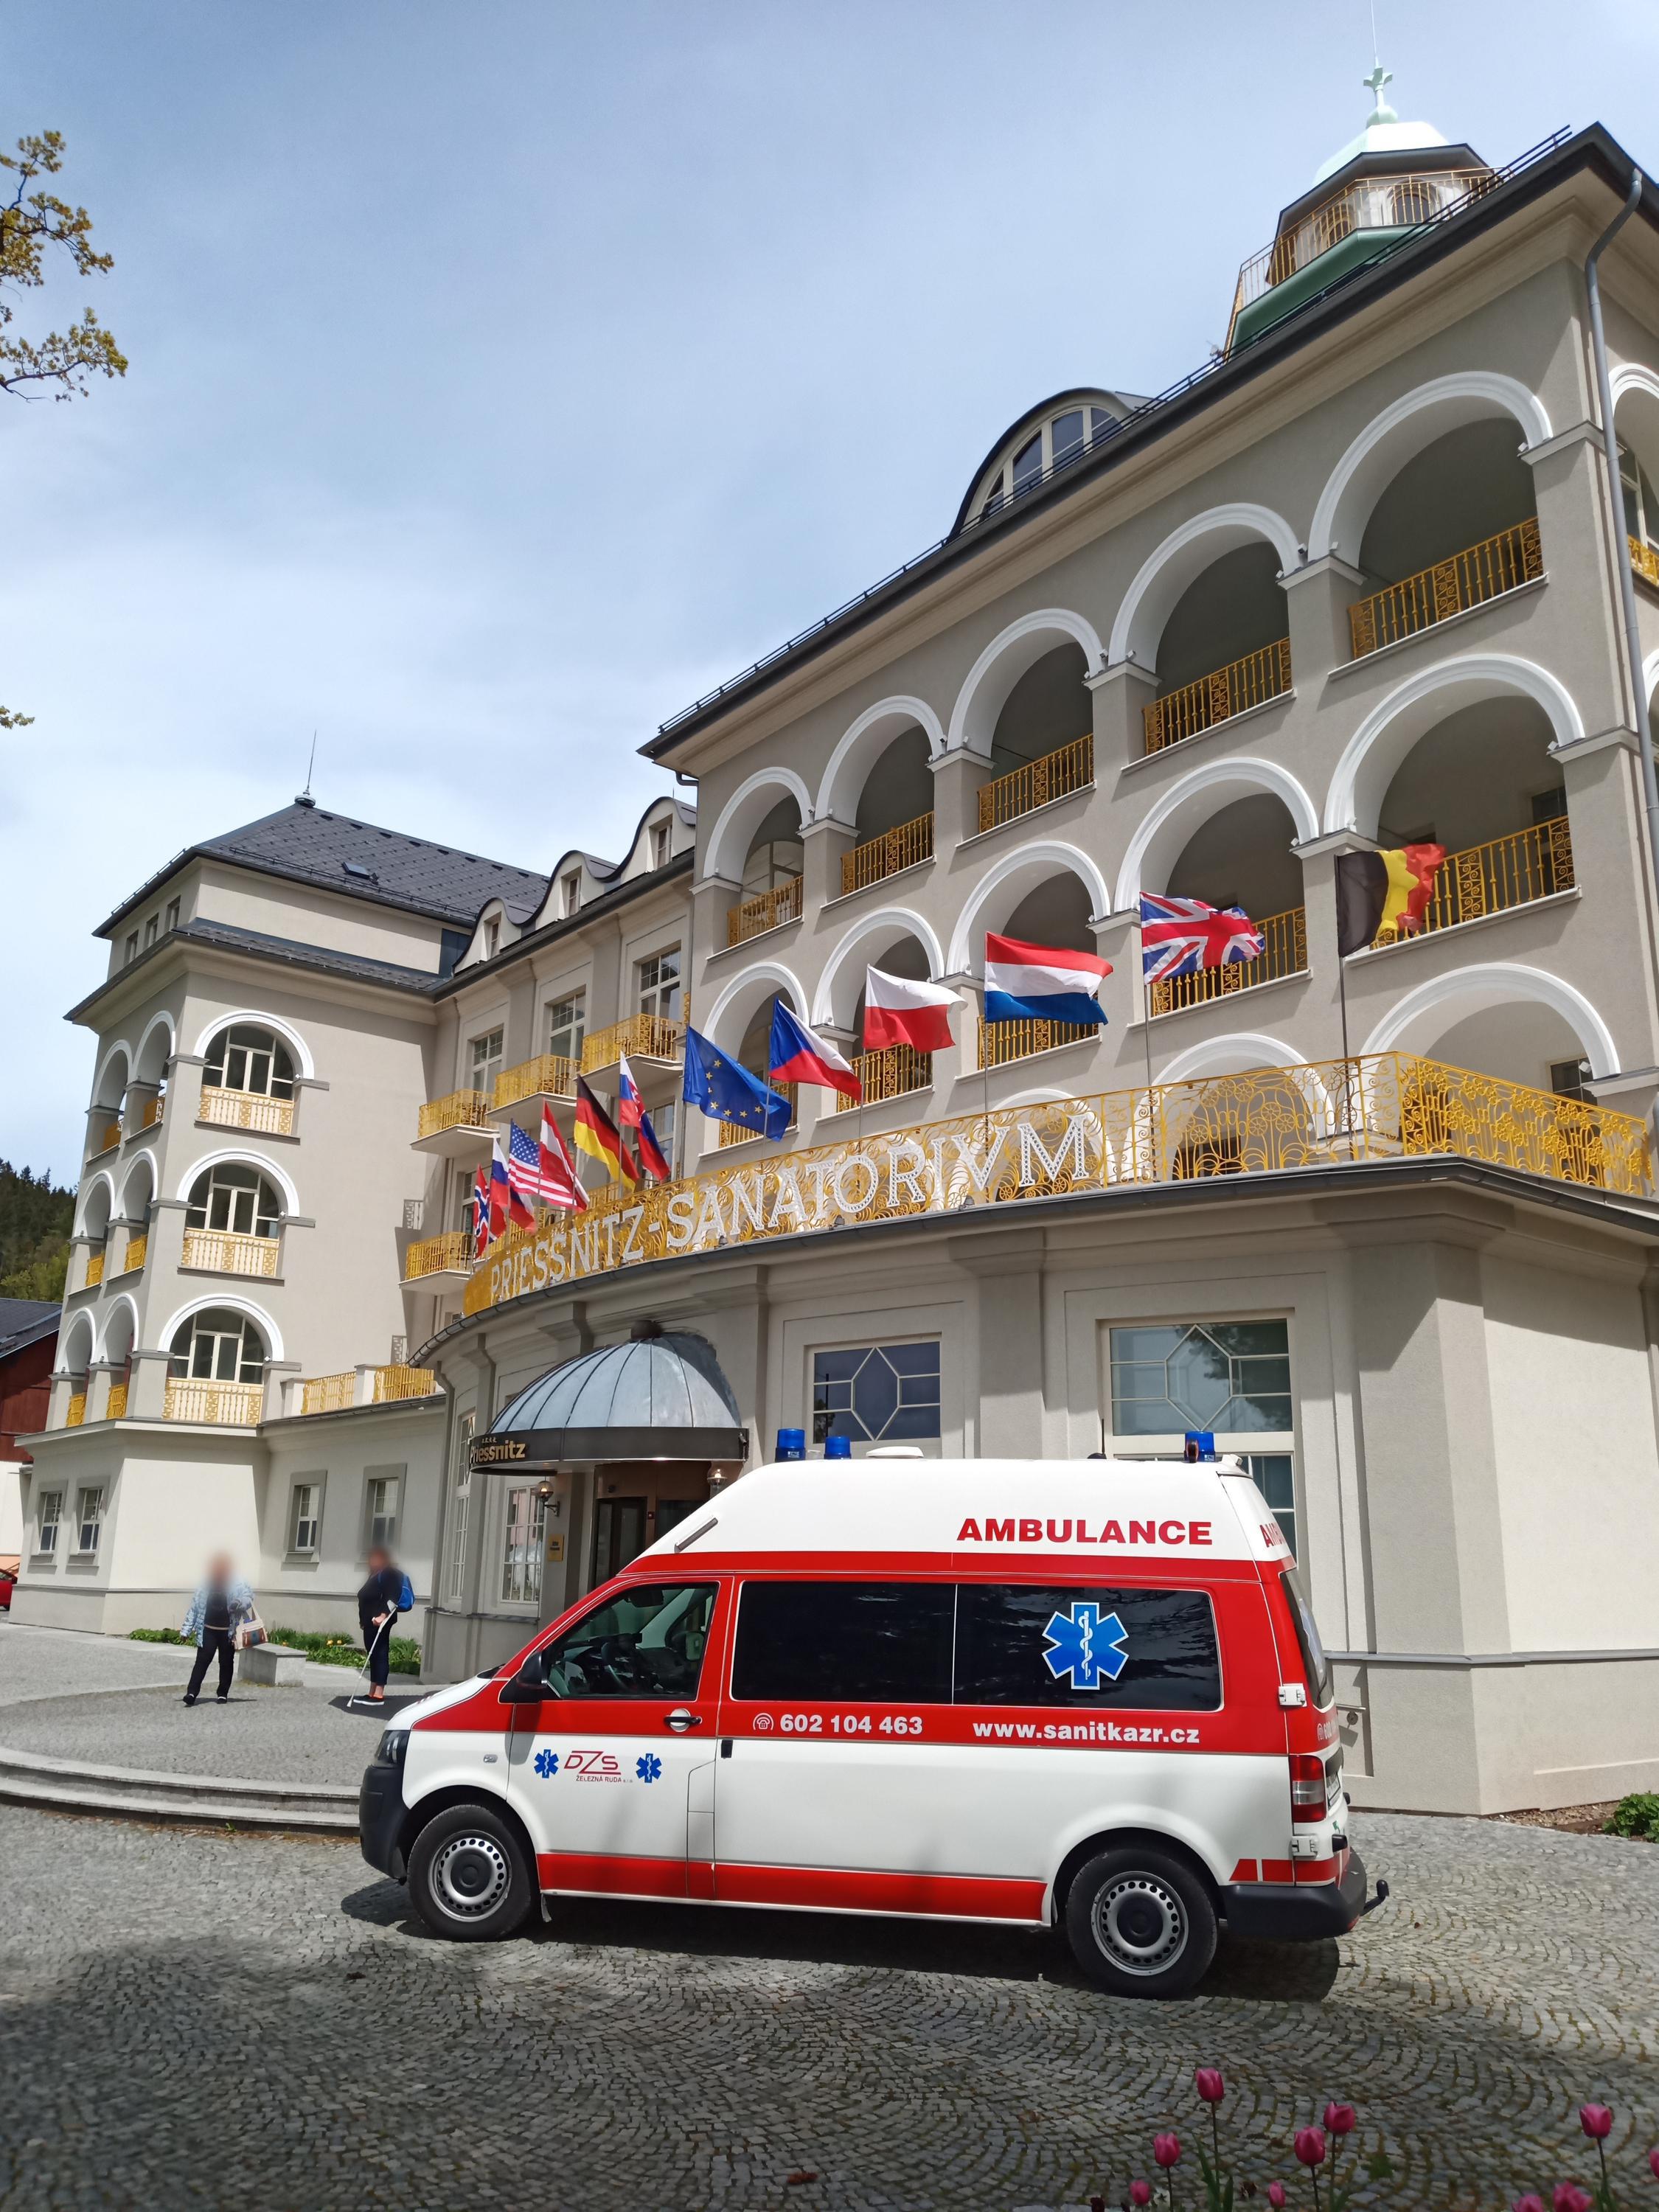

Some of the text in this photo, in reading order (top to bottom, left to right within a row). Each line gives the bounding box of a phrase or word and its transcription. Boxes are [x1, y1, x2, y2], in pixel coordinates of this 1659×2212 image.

[470, 1439, 526, 1464] Priessnitz
[957, 1518, 1213, 1545] AMBULANCE
[780, 1714, 922, 1734] 602 104 463
[973, 1722, 1200, 1744] www.sanitkazr.cz
[563, 1750, 622, 1775] DZS
